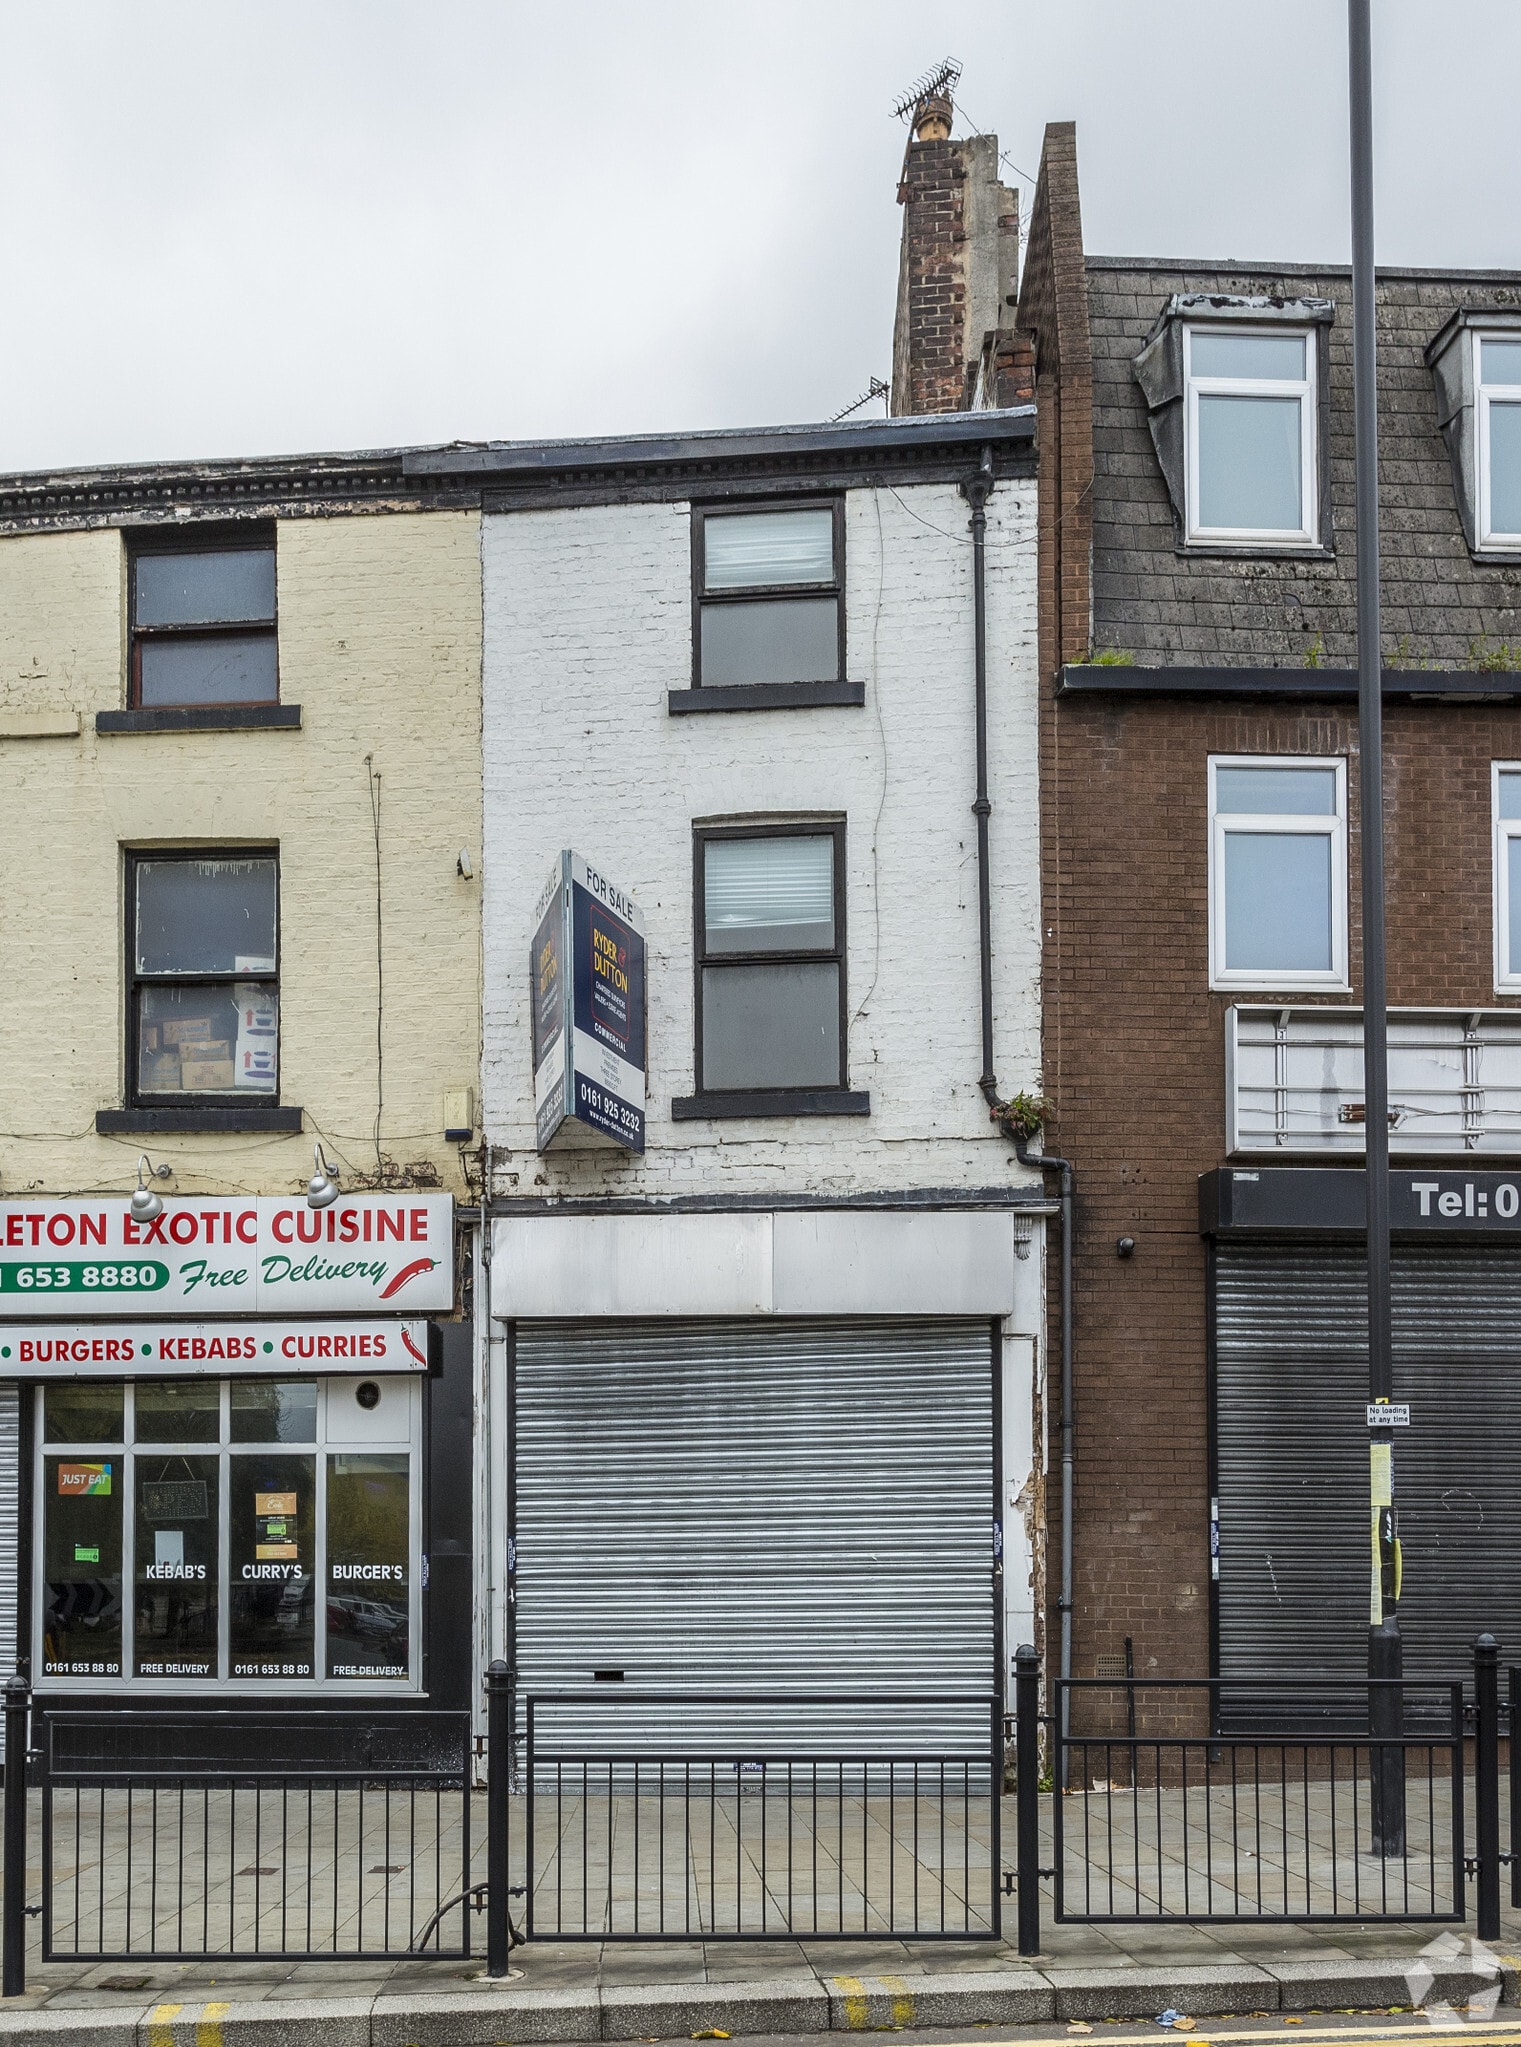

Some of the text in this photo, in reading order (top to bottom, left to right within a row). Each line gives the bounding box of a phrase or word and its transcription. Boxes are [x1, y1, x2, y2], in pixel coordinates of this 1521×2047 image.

[586, 866, 633, 922] FOR SALE
[593, 928, 618, 963] RYDER
[593, 951, 628, 994] DUTTON
[594, 1022, 627, 1053] COMMERCIAL
[581, 1083, 601, 1110] 0161
[604, 1097, 619, 1120] 925
[620, 1107, 640, 1132] 3232
[0, 1209, 428, 1247] ETON EXOTIC CUISINE
[16, 1267, 71, 1288] 653
[82, 1266, 157, 1287] 8880
[179, 1259, 249, 1295] Free
[261, 1255, 389, 1286] Delivery
[19, 1334, 387, 1362] BURGERS KEBABS CURRIES
[1382, 1407, 1407, 1415] loading
[62, 1474, 108, 1486] JUST EAT
[146, 1565, 206, 1579] KEBAB'S
[242, 1564, 303, 1579] CURRY'S
[332, 1565, 403, 1580] BURGER'S
[45, 1662, 119, 1673] 0161 653 88 80
[140, 1663, 209, 1674] FREE DELIVERY
[234, 1665, 310, 1675] 0161 653 88 80
[333, 1665, 404, 1676] FREE DELIVERY
